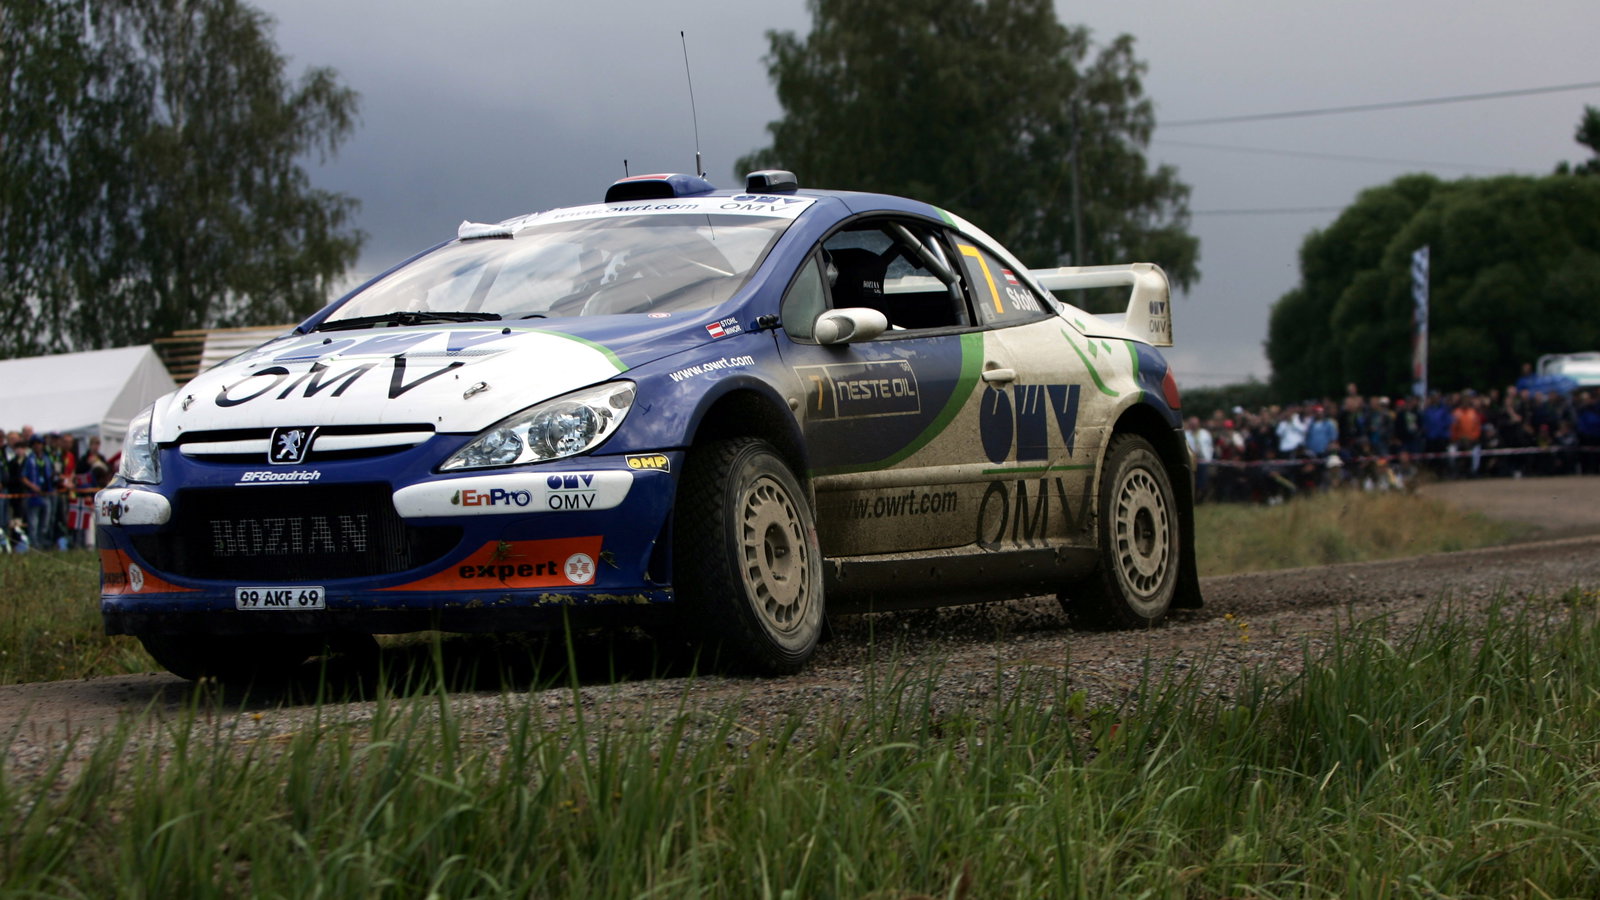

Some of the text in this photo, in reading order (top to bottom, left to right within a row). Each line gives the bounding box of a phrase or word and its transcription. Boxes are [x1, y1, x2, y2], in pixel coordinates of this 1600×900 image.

[720, 203, 789, 213] OMV
[957, 244, 1004, 313] 7
[1005, 287, 1040, 312] Stohl
[720, 317, 738, 328] STOHL
[724, 325, 741, 335] MINOR
[1150, 319, 1166, 333] OMV
[669, 355, 755, 382] www.owrt.com
[215, 353, 466, 407] OMV
[837, 378, 915, 400] NESTE OIL
[808, 375, 824, 411] 7
[628, 456, 667, 469] OMP
[241, 470, 321, 482] BFGoodrich
[462, 488, 532, 507] EnPro
[549, 493, 596, 510] OMV
[976, 476, 1094, 551] OMV
[210, 514, 368, 556] BOZIAN
[459, 560, 558, 581] expert
[240, 590, 319, 606] 99 AKF 69
